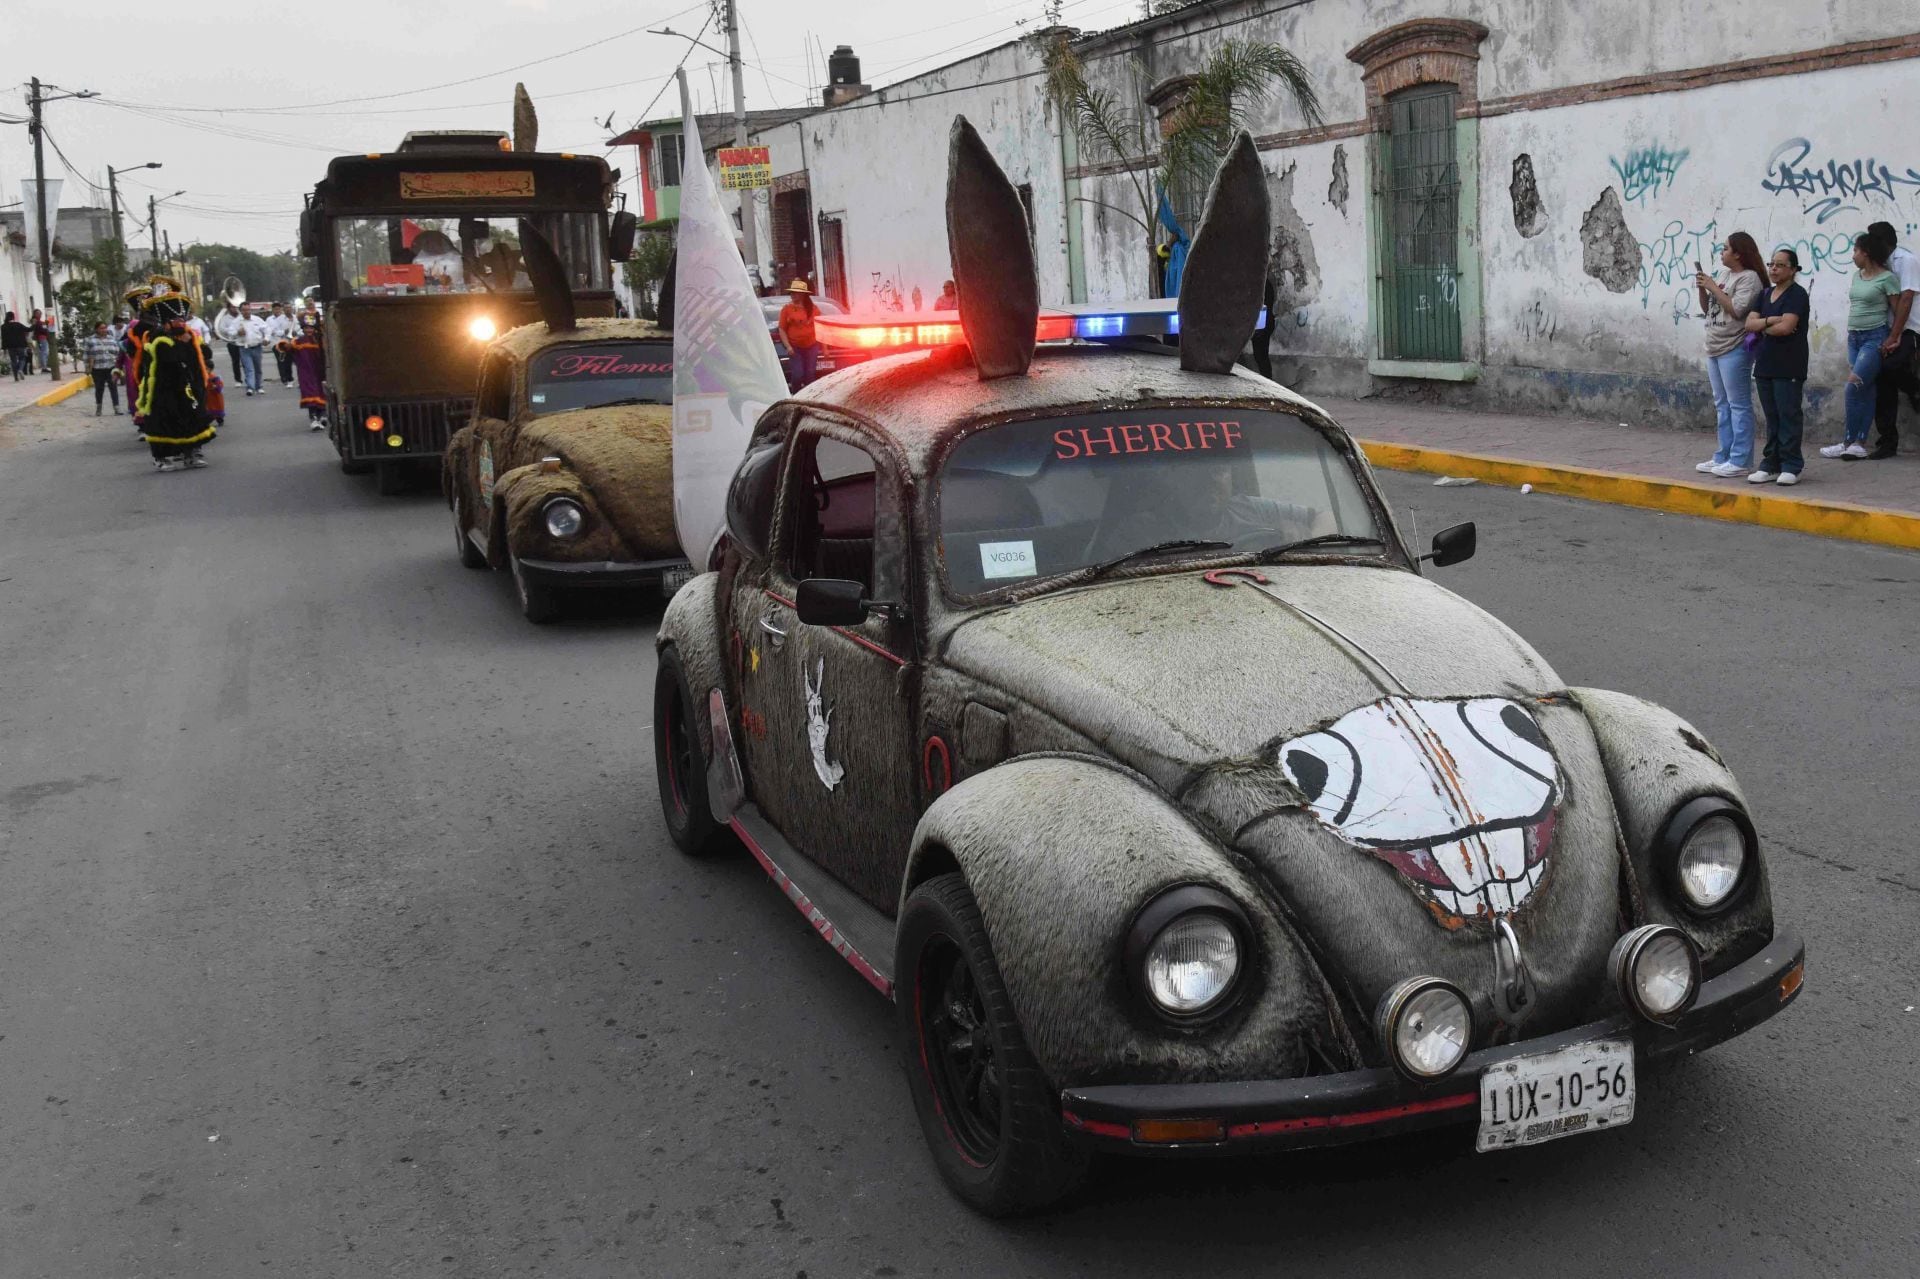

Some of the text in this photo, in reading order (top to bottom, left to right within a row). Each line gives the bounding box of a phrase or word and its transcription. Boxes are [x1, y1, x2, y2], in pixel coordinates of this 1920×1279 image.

[1053, 421, 1242, 460] SHERIFF
[990, 551, 1026, 562] VG036
[1490, 1062, 1626, 1126] LUX-10-56
